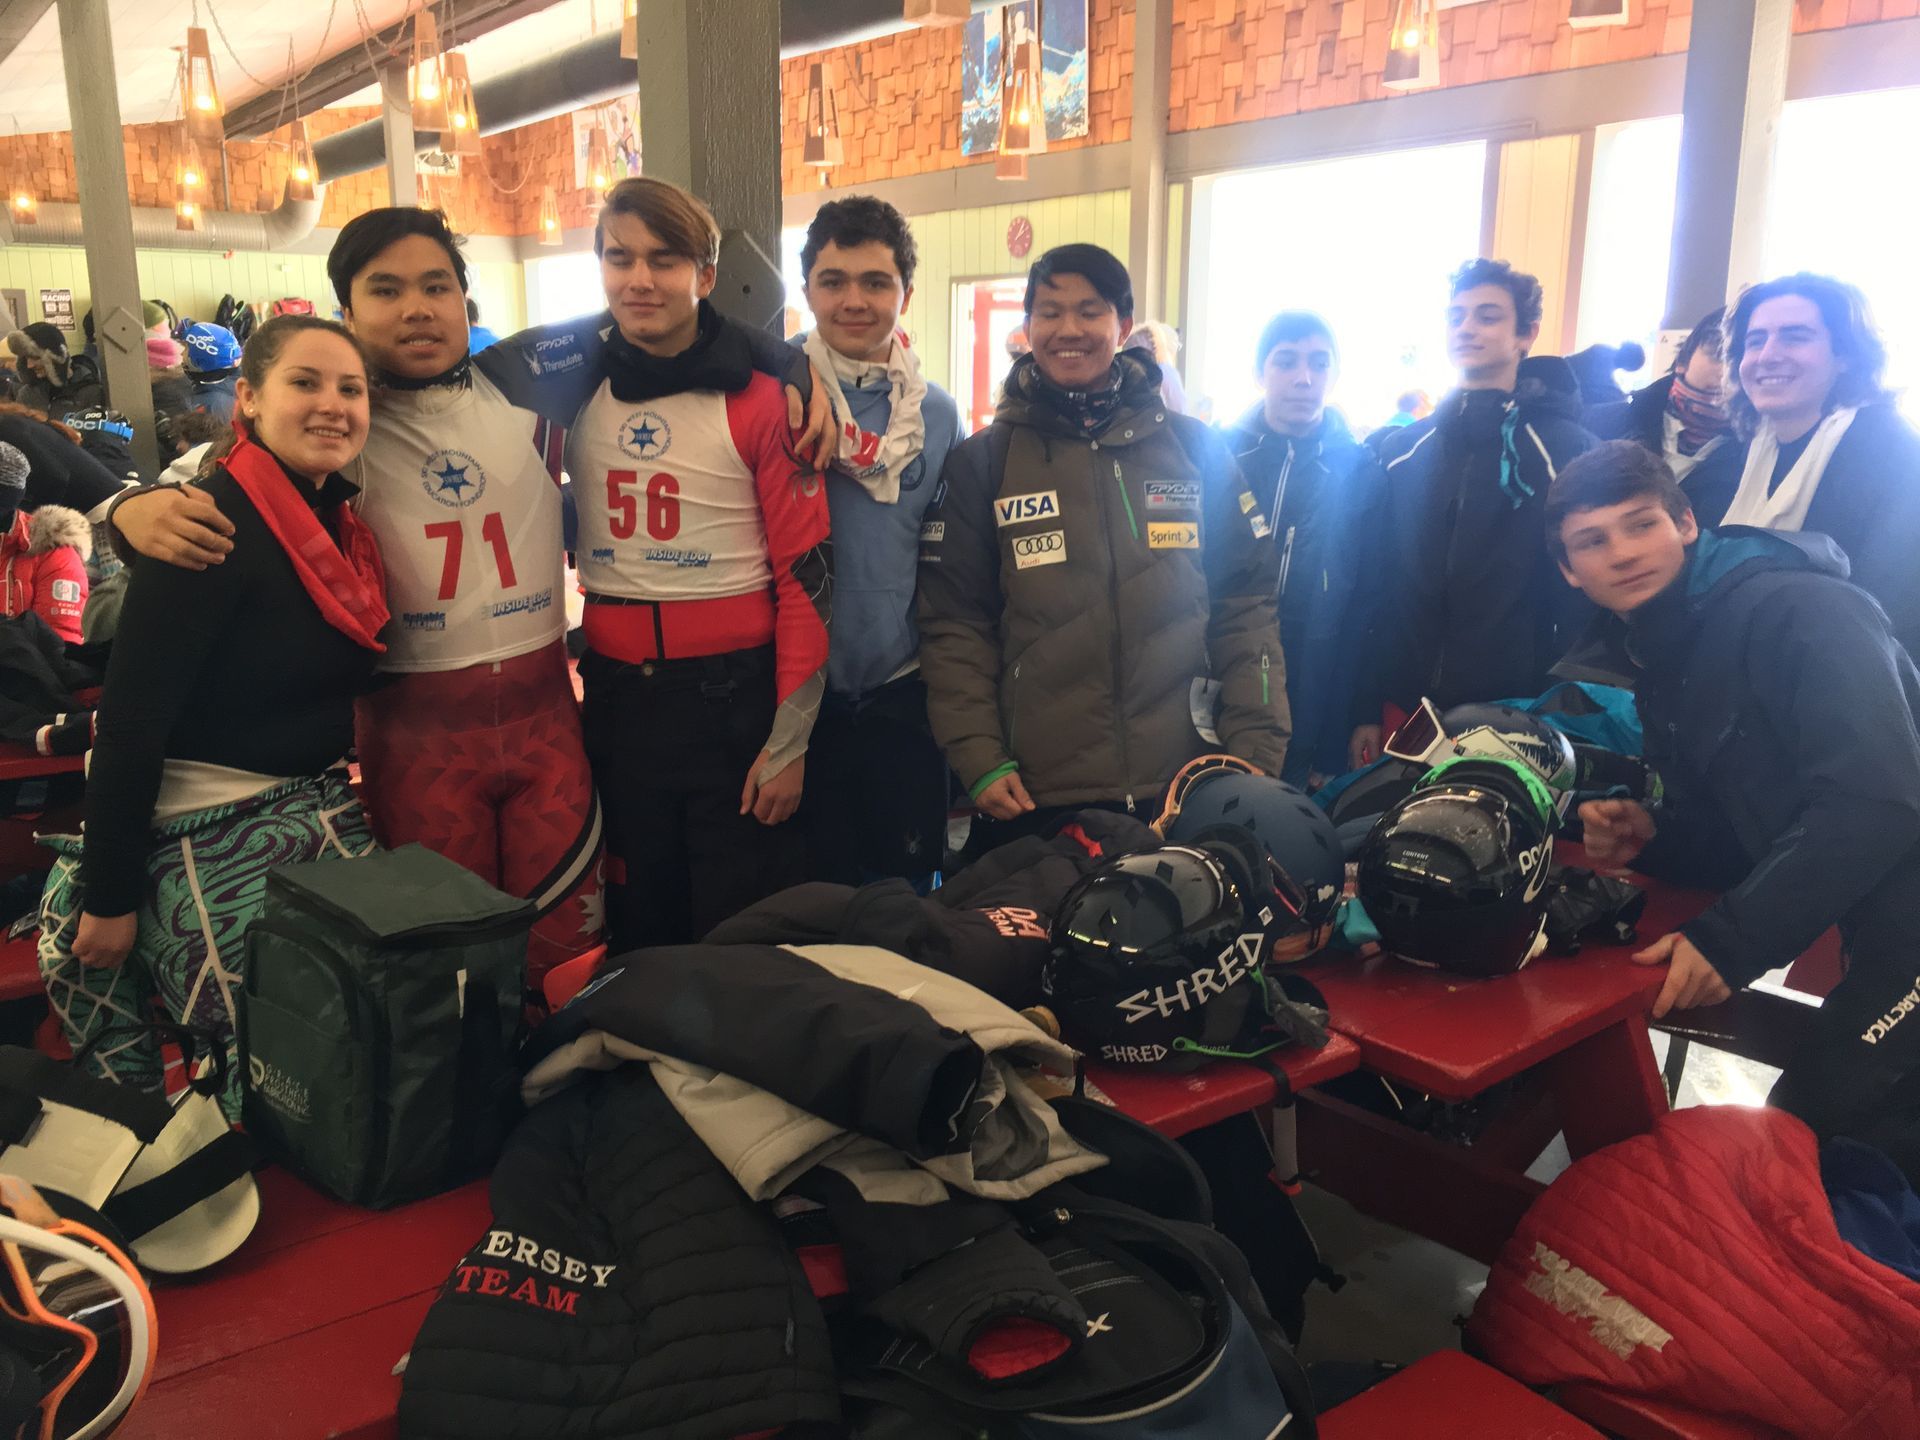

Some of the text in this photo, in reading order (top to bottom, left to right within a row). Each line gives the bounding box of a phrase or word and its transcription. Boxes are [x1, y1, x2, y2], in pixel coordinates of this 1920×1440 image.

[606, 469, 681, 542] 56
[998, 495, 1056, 522] VISA
[424, 511, 518, 601] 71
[645, 547, 682, 561] INSIDE
[1150, 530, 1181, 545] Sprint
[1020, 558, 1041, 569] Audi
[492, 596, 530, 618] INSIDE
[1115, 933, 1265, 1024] SHRED
[1861, 988, 1920, 1045] ARCTICA
[1102, 1044, 1168, 1063] SHRED
[481, 1230, 617, 1289] ERSEY
[455, 1265, 581, 1316] TEAM
